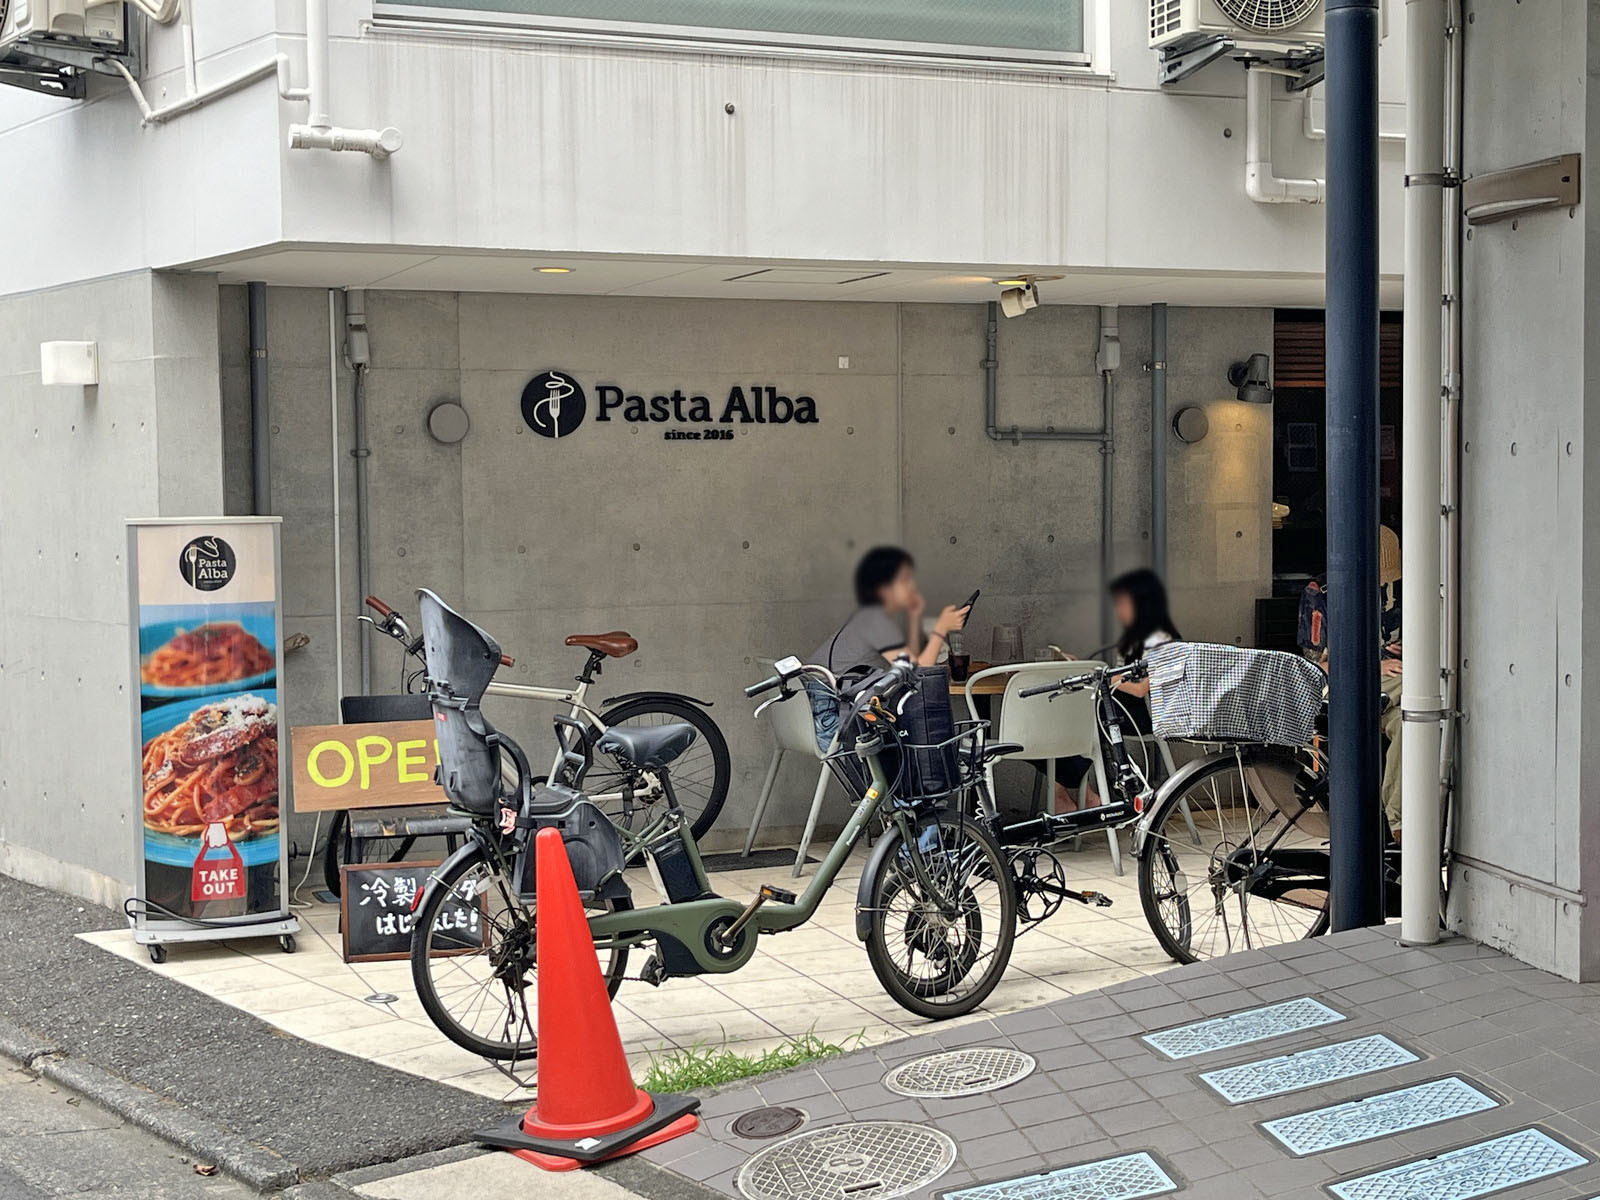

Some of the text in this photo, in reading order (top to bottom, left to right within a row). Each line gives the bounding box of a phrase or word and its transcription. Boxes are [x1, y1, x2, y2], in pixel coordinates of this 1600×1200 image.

[595, 385, 819, 423] Pasta Alba
[664, 429, 734, 440] since 2016
[198, 558, 227, 568] Pasta
[198, 568, 228, 579] Alba
[199, 868, 238, 882] TAKE
[203, 882, 235, 895] OUT
[359, 877, 477, 907] 冷製タ
[376, 907, 479, 935] はじした!
